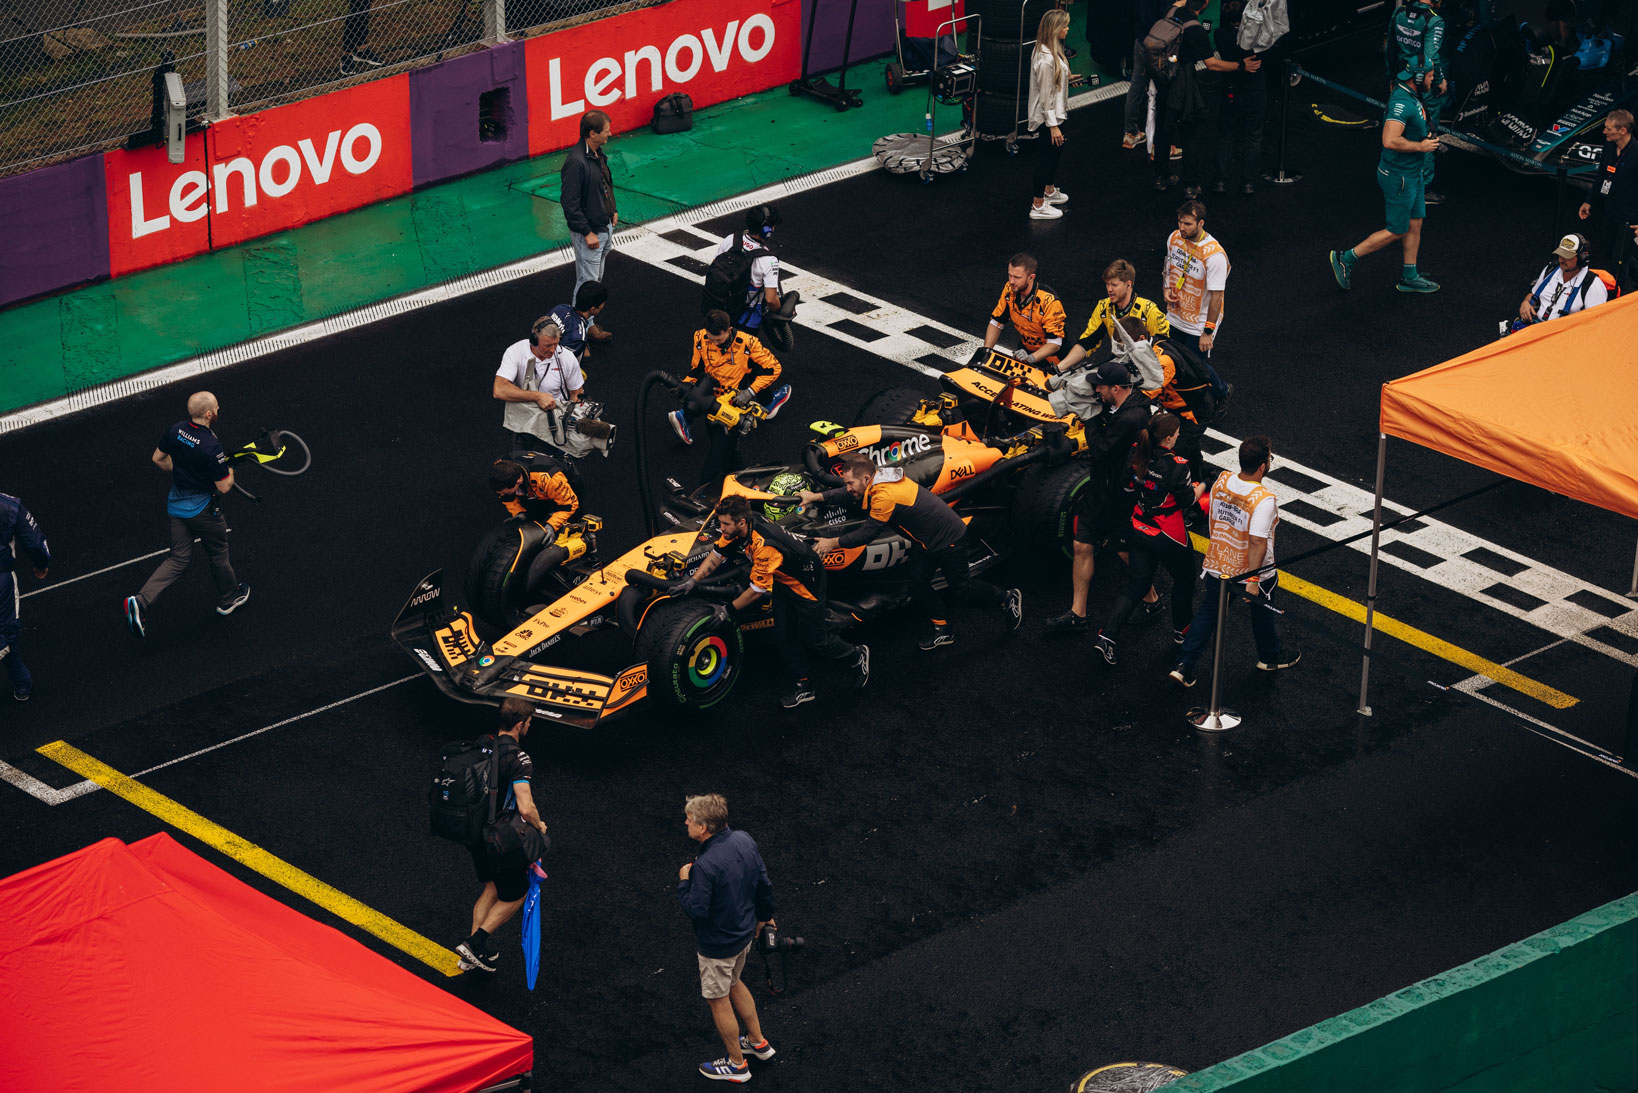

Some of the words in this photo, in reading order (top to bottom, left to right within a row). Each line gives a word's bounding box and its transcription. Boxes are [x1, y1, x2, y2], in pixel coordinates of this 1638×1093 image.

[1396, 35, 1421, 48] aramco
[549, 13, 776, 121] Lenovo
[129, 122, 383, 239] Lenovo
[742, 240, 754, 250] UGO
[971, 381, 1041, 416] ACCEATING
[177, 428, 201, 445] WILLIAMS
[177, 435, 196, 448] RACING
[837, 435, 859, 450] OXXO
[951, 464, 974, 480] DELL
[823, 553, 845, 566] XXO
[620, 673, 646, 689] OXXO
[672, 662, 687, 704] Cinturato
